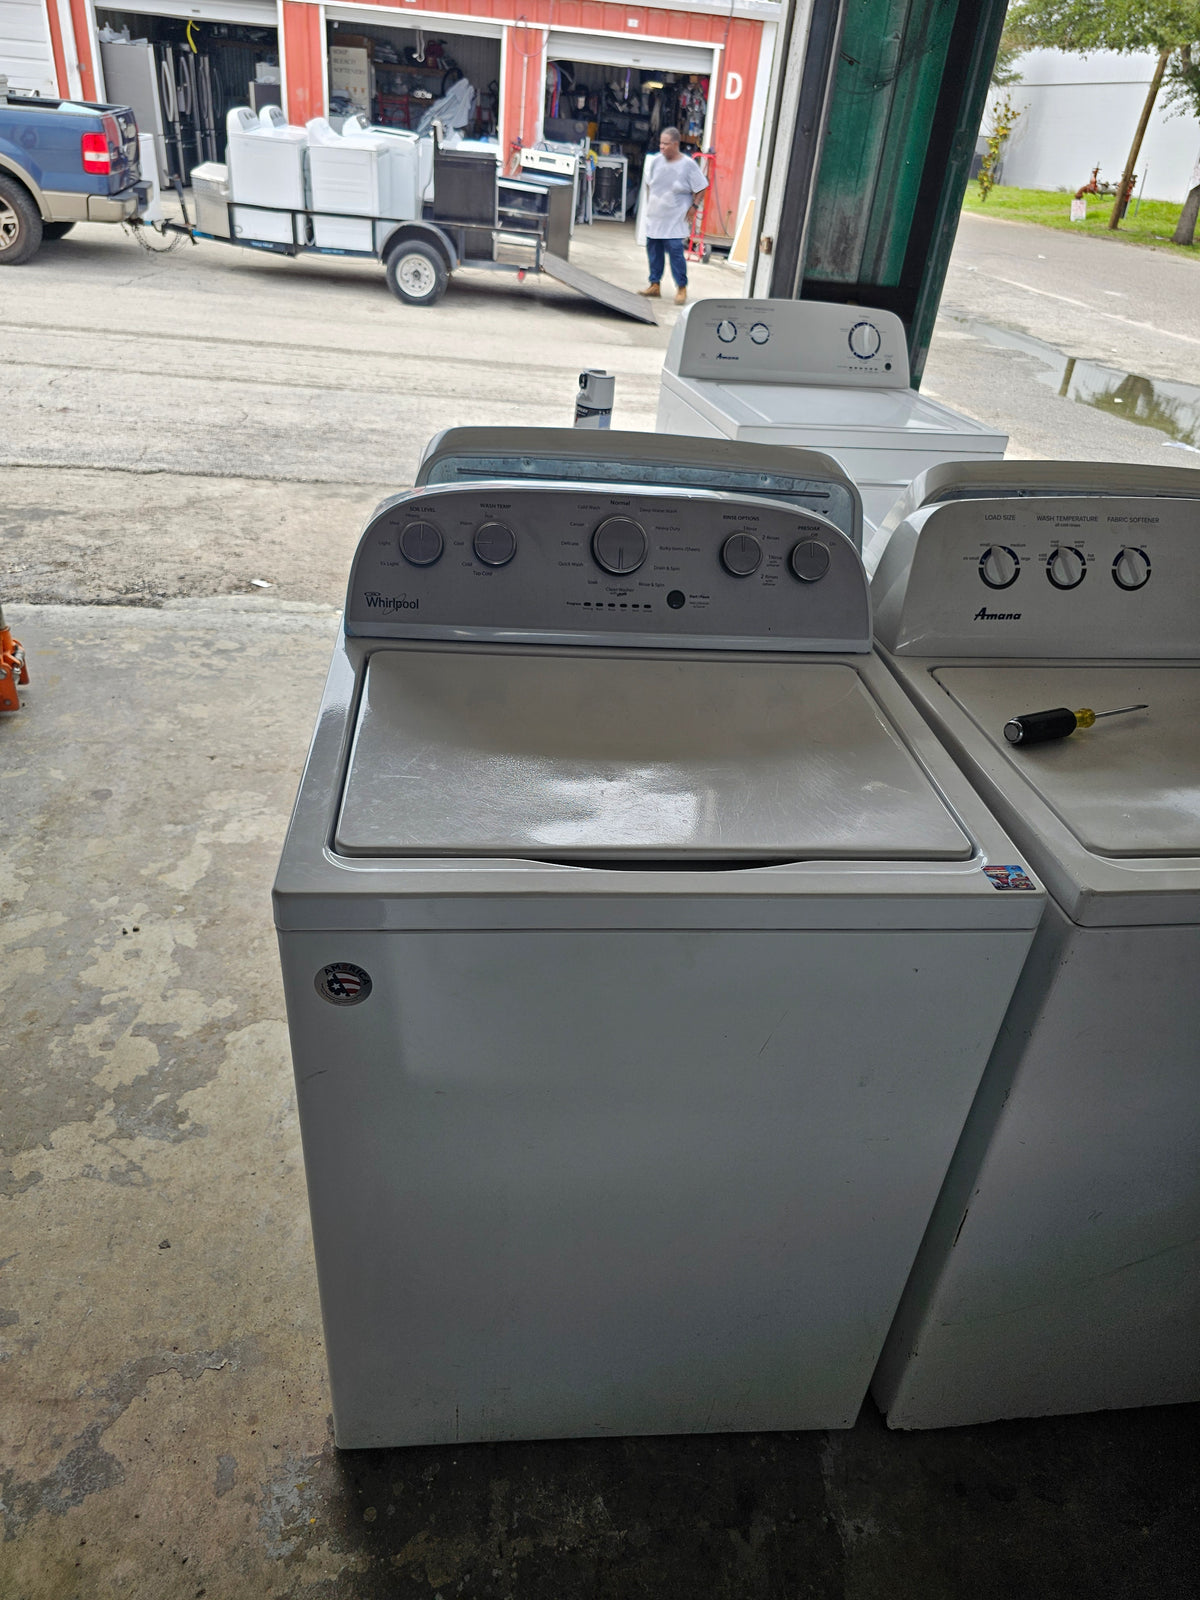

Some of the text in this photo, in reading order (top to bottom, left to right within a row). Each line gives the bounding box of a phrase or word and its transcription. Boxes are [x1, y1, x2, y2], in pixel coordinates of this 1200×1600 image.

[724, 72, 743, 100] D
[366, 597, 419, 612] Whirlpool
[973, 607, 1022, 621] Amana
[324, 964, 370, 986] AMERICA
